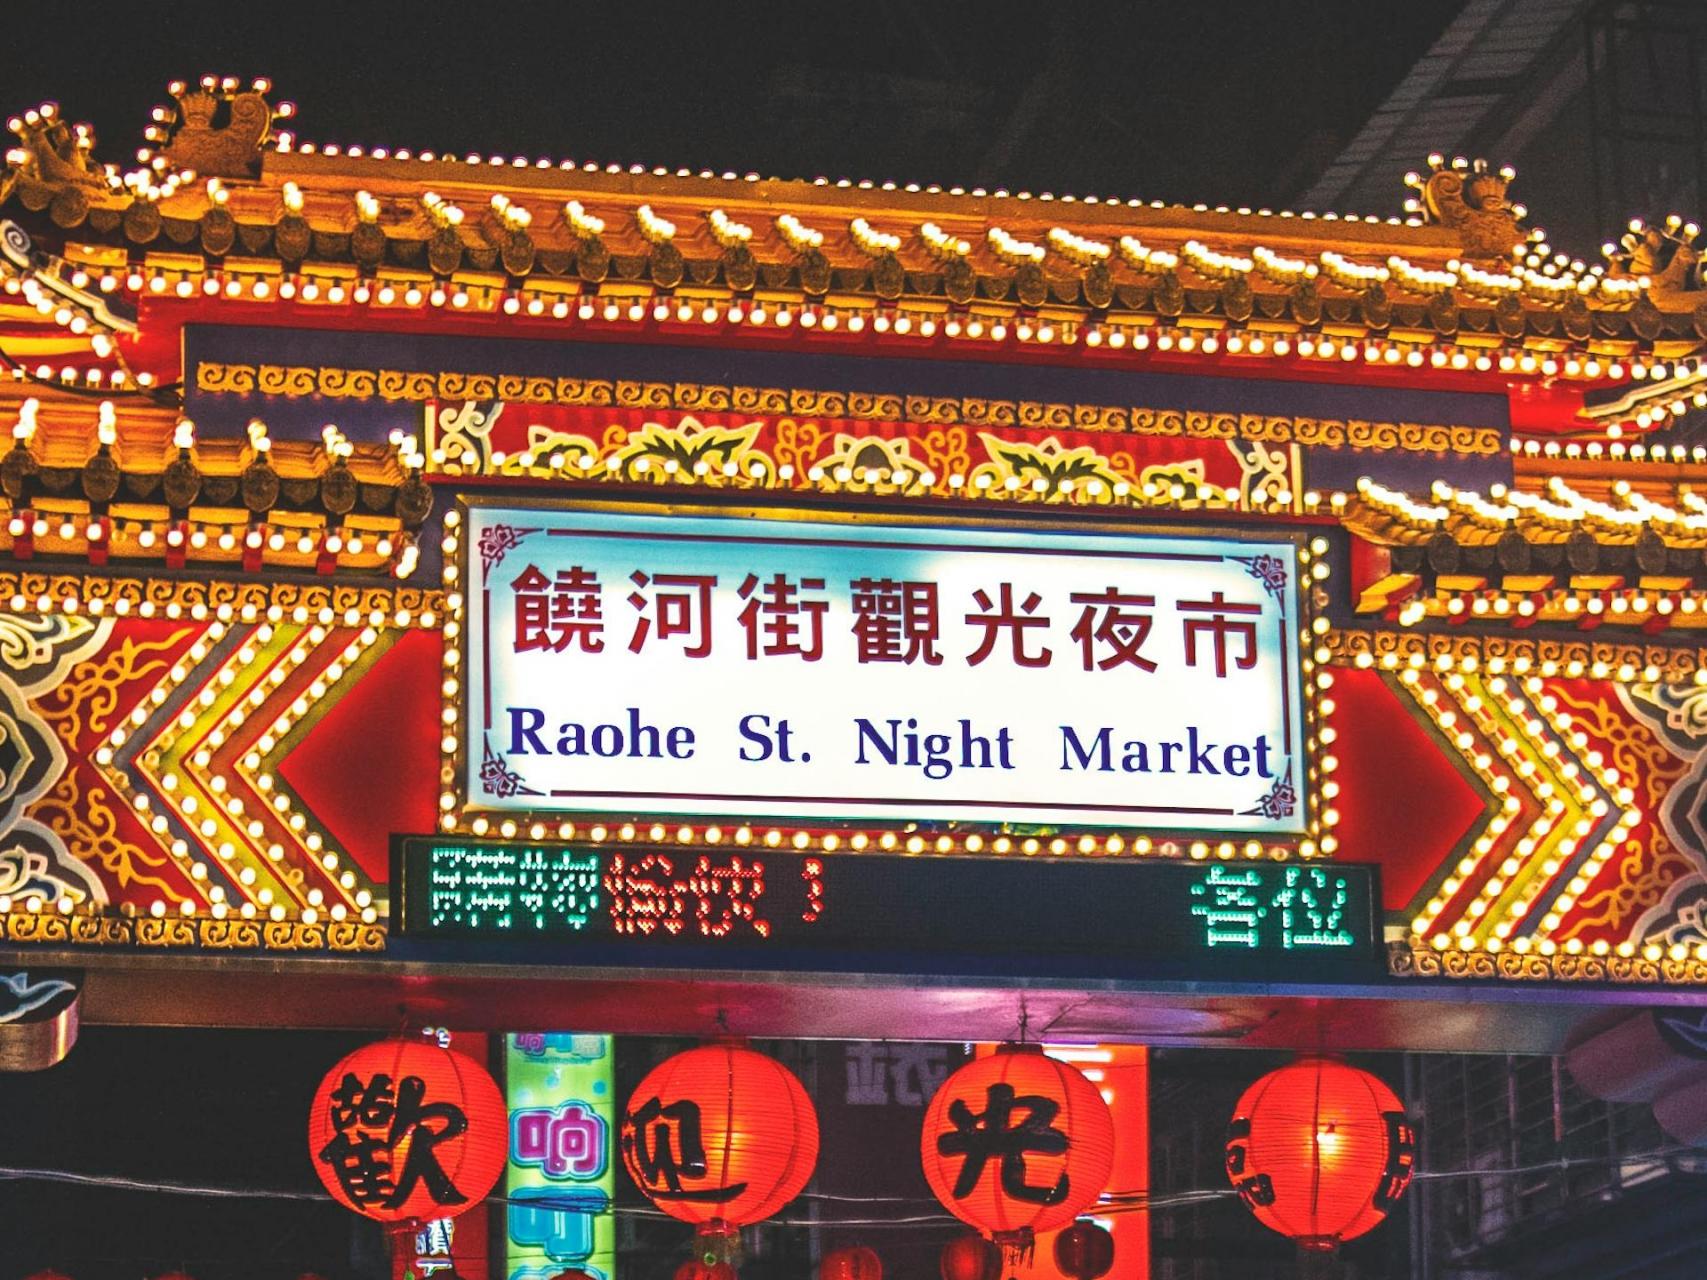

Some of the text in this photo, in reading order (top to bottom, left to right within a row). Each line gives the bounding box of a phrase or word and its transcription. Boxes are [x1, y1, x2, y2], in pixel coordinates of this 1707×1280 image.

[509, 563, 1267, 680] 饒河街觀光夜市
[506, 705, 1275, 780] Raohe St. Night Market
[319, 1072, 469, 1212] 歡
[936, 1082, 1071, 1206] 光
